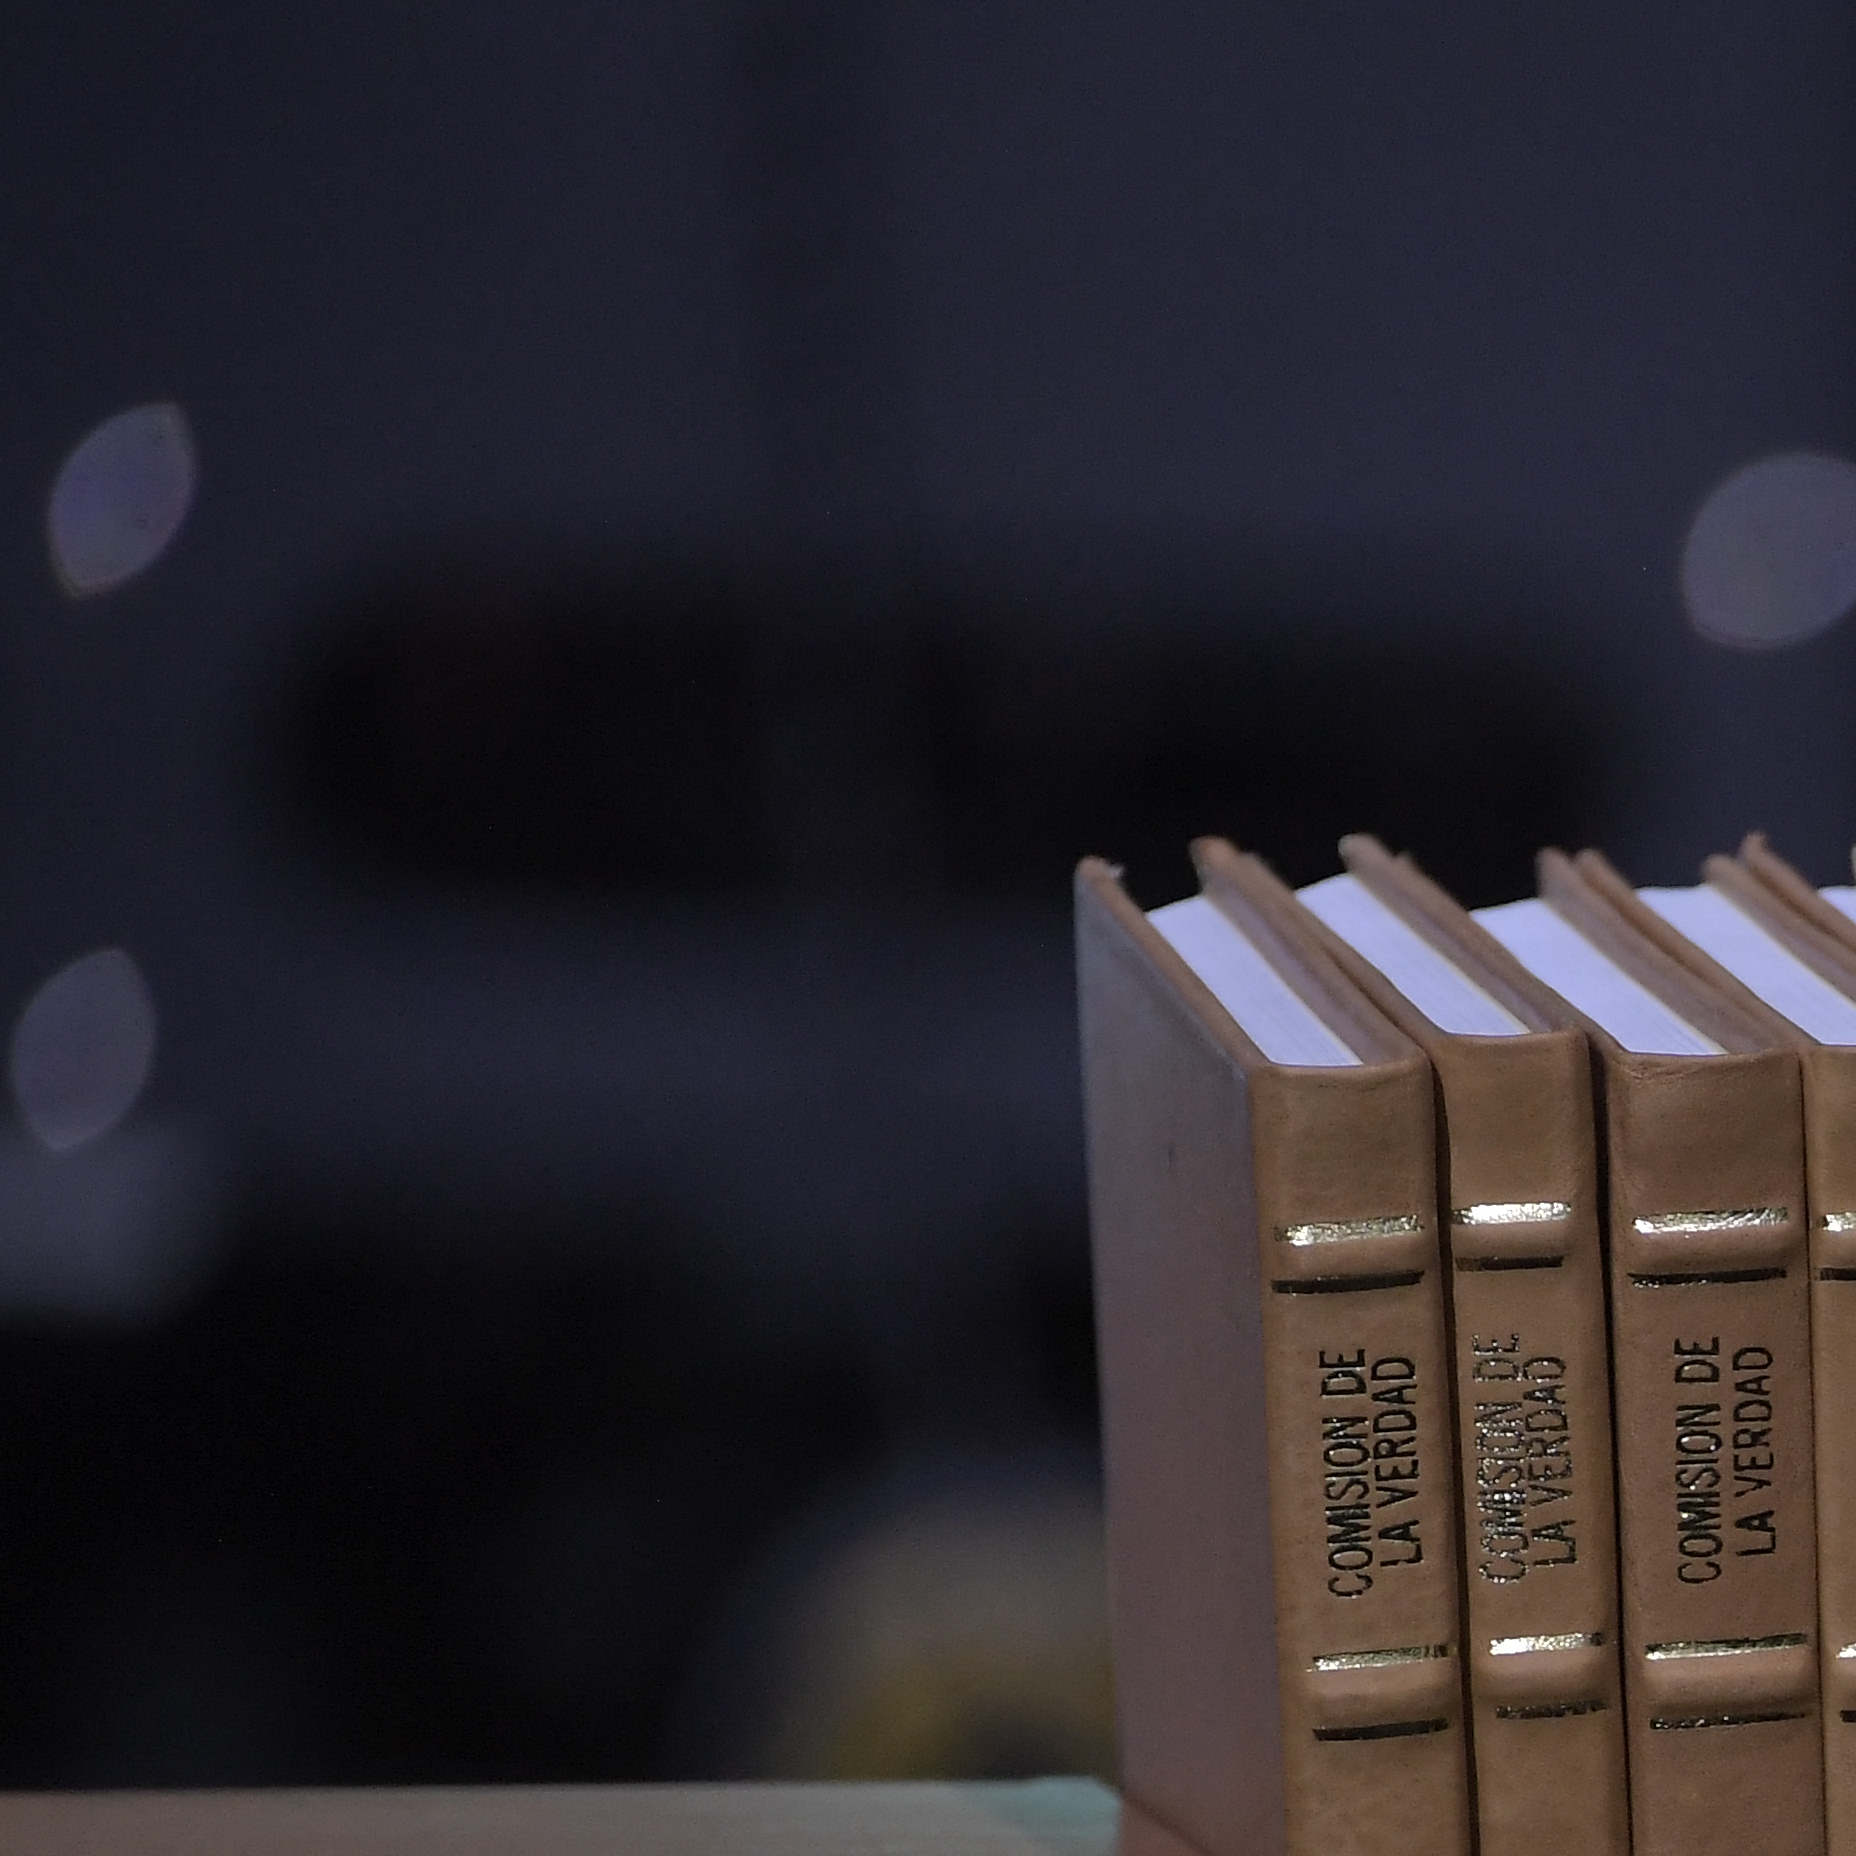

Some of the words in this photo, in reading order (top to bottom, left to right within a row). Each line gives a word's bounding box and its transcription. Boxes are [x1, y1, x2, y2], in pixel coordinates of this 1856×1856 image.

[1319, 1347, 1367, 1398] DE
[1471, 1332, 1520, 1384] DE
[1674, 1335, 1721, 1384] DE
[1371, 1355, 1420, 1514] VERDAD
[1523, 1355, 1572, 1510] VERDAD
[1732, 1345, 1775, 1496] VERDAD
[1322, 1415, 1374, 1597] COMISION
[1475, 1400, 1528, 1584] COMISION
[1674, 1403, 1723, 1585] COMISION
[1735, 1509, 1777, 1557] LA
[1380, 1518, 1424, 1568] LA
[1531, 1518, 1578, 1568] LA
